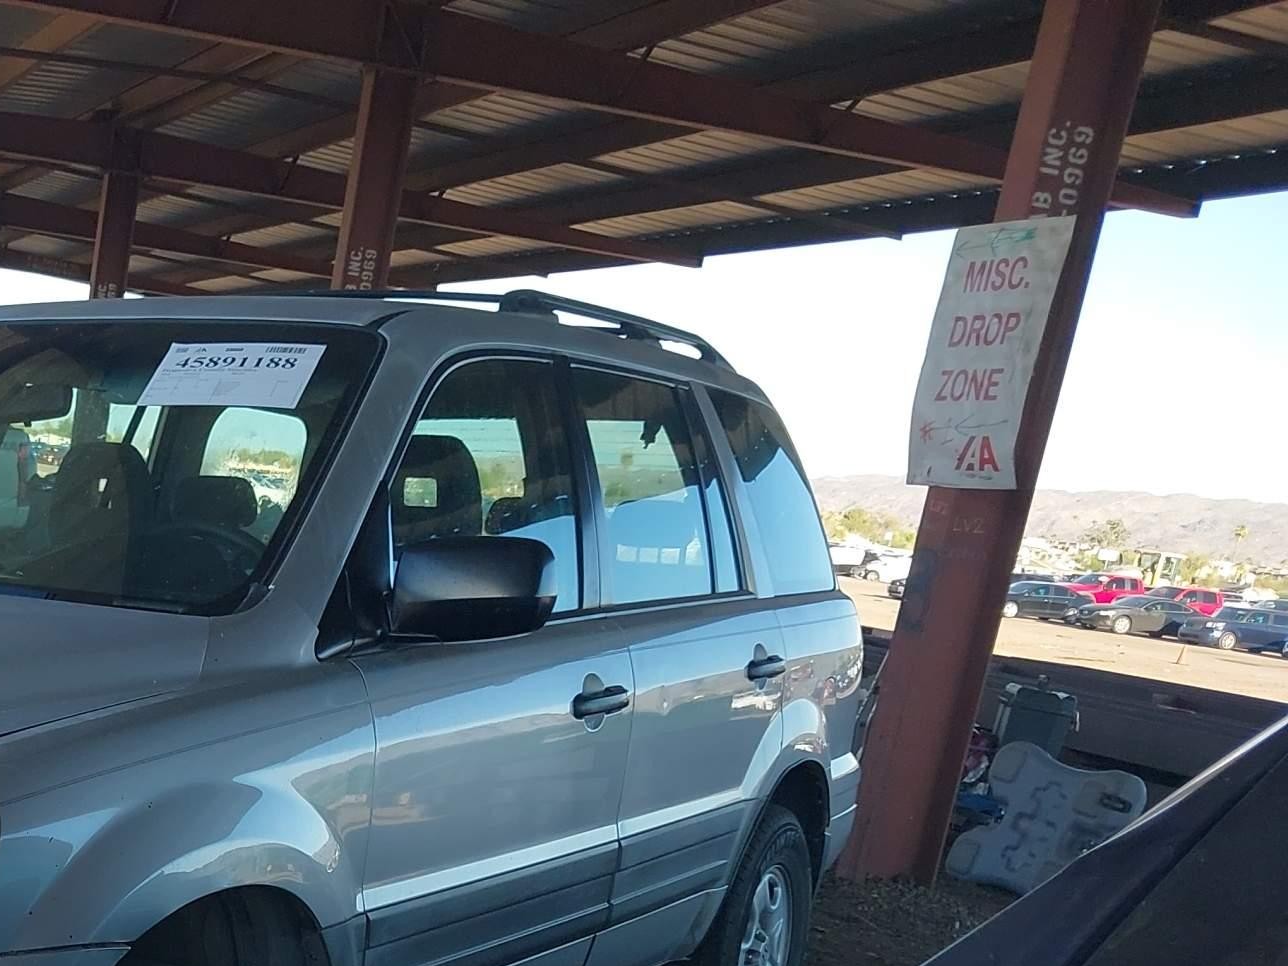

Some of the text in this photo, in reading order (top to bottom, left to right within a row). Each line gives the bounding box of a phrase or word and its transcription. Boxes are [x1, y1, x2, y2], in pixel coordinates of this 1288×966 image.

[1039, 120, 1071, 177] INC.
[348, 247, 364, 276] INC.
[963, 256, 1030, 292] MISC.
[947, 312, 1022, 348] DROP
[176, 356, 298, 369] 45891188
[935, 368, 1004, 401] ZONE
